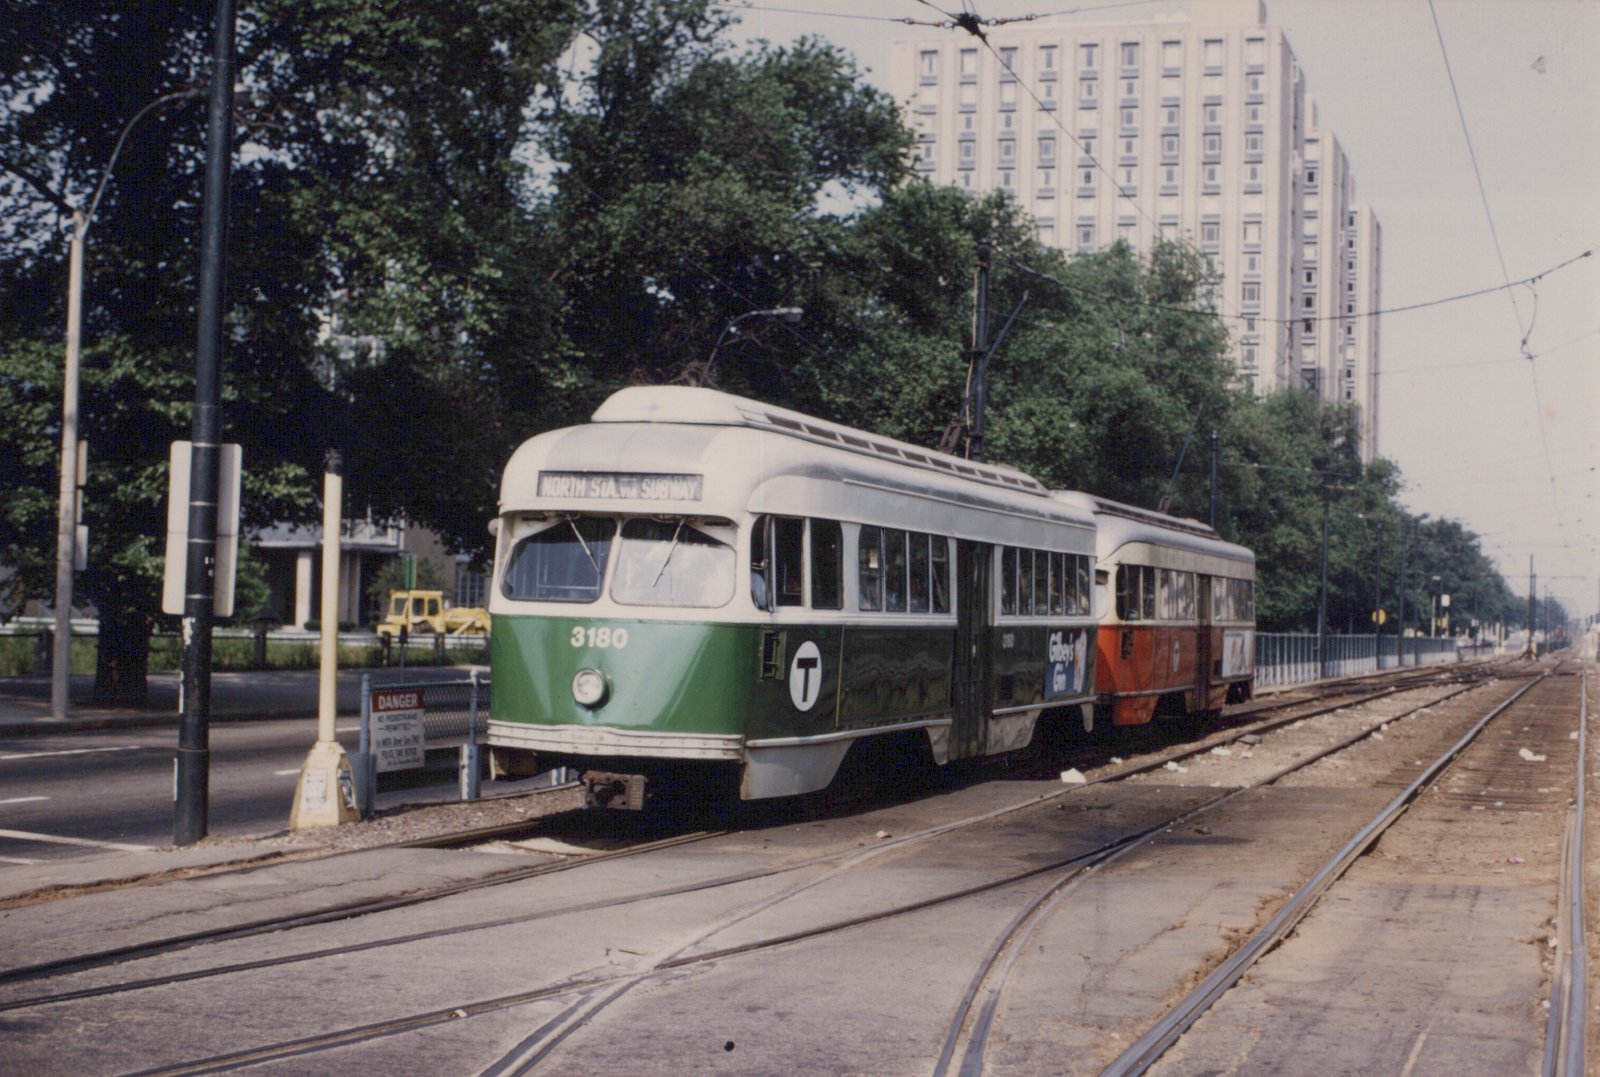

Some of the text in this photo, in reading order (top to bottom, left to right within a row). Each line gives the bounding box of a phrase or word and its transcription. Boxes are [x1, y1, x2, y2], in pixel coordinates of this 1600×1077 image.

[541, 476, 586, 498] NORTH
[641, 478, 699, 501] SUBWAY
[570, 626, 629, 649] 3180
[796, 657, 818, 702] T
[1053, 663, 1067, 692] Gin
[378, 693, 418, 710] DANGER
